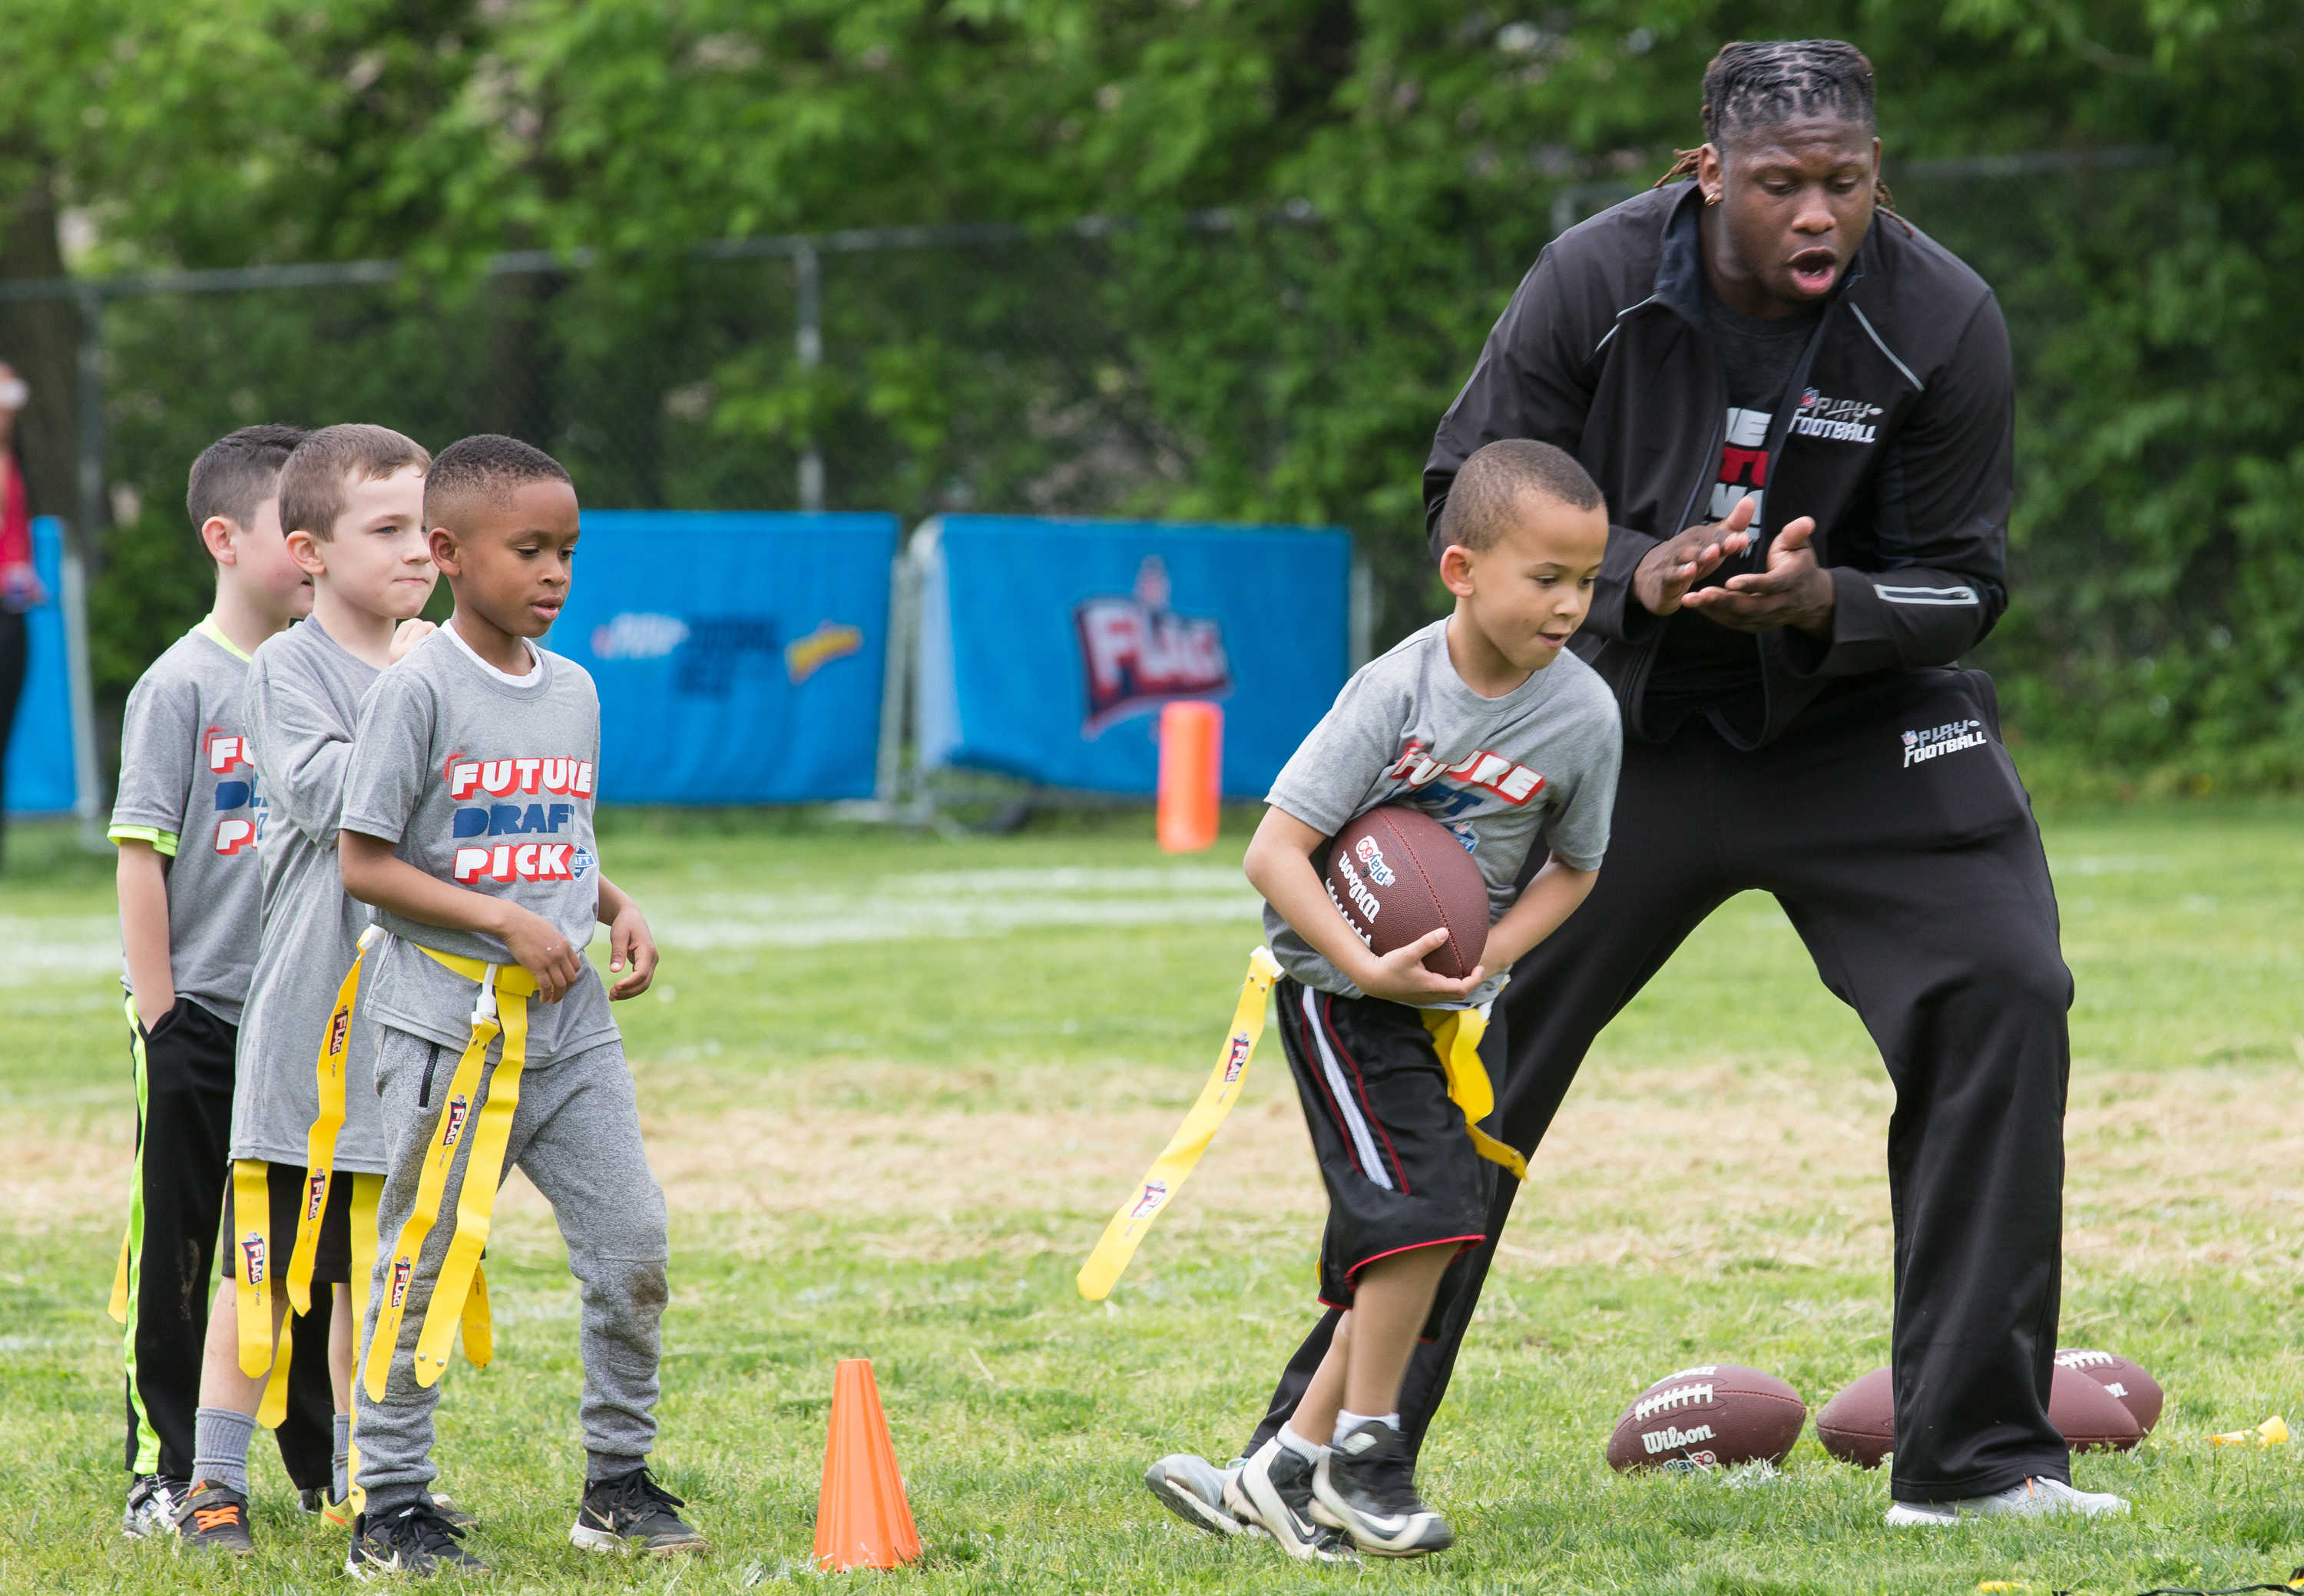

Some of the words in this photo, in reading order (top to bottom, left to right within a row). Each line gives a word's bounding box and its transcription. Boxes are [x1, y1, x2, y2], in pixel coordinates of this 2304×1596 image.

[1788, 408, 1876, 443] FOOTBALL
[1812, 397, 1874, 423] PLAY
[1904, 731, 1987, 768] FOOTBALL
[1919, 720, 1968, 747] PLAY
[454, 843, 572, 882] PICK
[1339, 850, 1381, 924] Wilson
[332, 1014, 348, 1054] FLAG
[445, 1107, 465, 1144] FLAG
[310, 1180, 324, 1219] FLAG
[249, 1243, 264, 1283] FLAG
[392, 1268, 409, 1306] FLAG
[1641, 1425, 1716, 1455] Wilson
